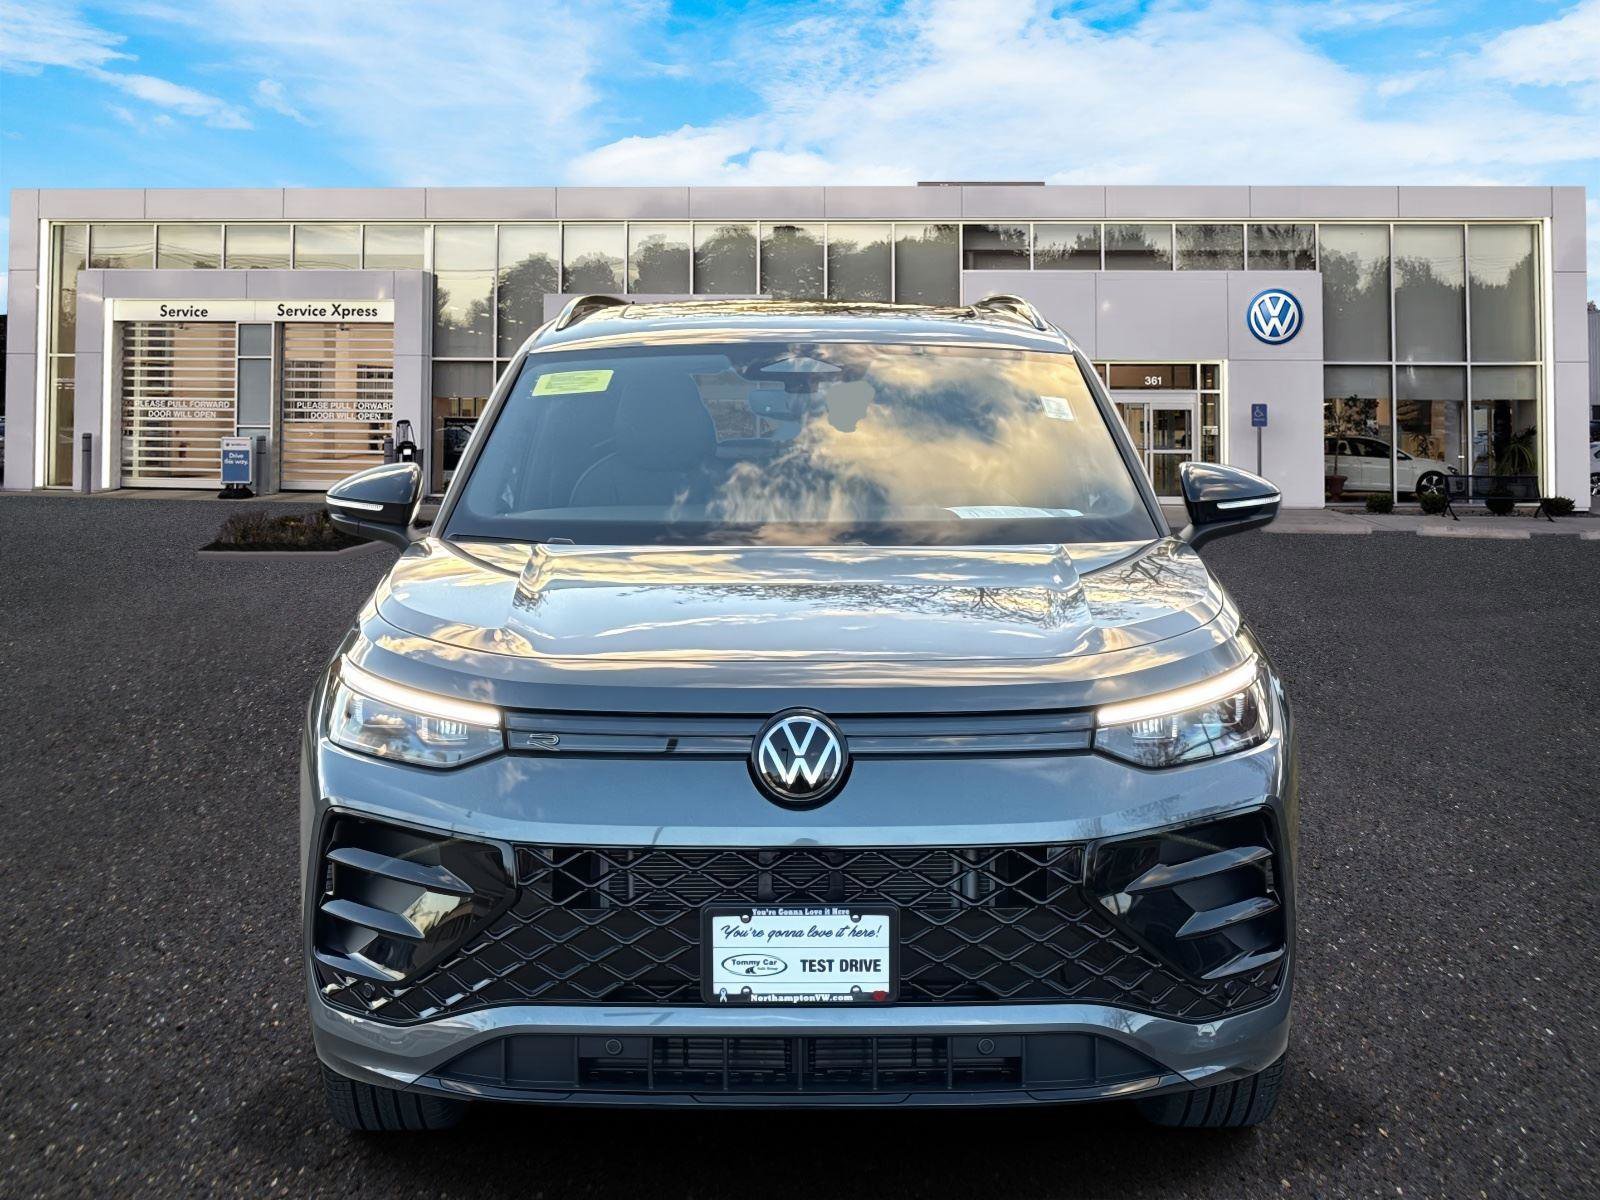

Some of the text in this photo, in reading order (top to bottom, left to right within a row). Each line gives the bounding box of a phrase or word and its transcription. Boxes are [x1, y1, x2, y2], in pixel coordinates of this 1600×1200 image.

[159, 305, 208, 318] Service
[277, 304, 378, 319] Service Xpress
[1144, 376, 1162, 386] 361
[135, 400, 230, 409] PLEASE PULL FORWARD
[296, 401, 328, 409] PLEASE
[330, 401, 352, 409] PULL
[148, 410, 171, 418] DOOR
[173, 410, 193, 418] WILL
[357, 412, 380, 420] OPEN
[752, 908, 776, 916] You're
[778, 908, 803, 916] Gonna
[804, 908, 823, 916] Love
[831, 907, 850, 916] Here
[720, 925, 765, 939] You're
[766, 929, 804, 943] gonna
[806, 925, 834, 938] love
[847, 925, 882, 938] here!
[731, 958, 778, 966] Tommy Car
[800, 959, 881, 973] TEST DRIVE
[751, 993, 853, 1003] NorthamptonVW.com
